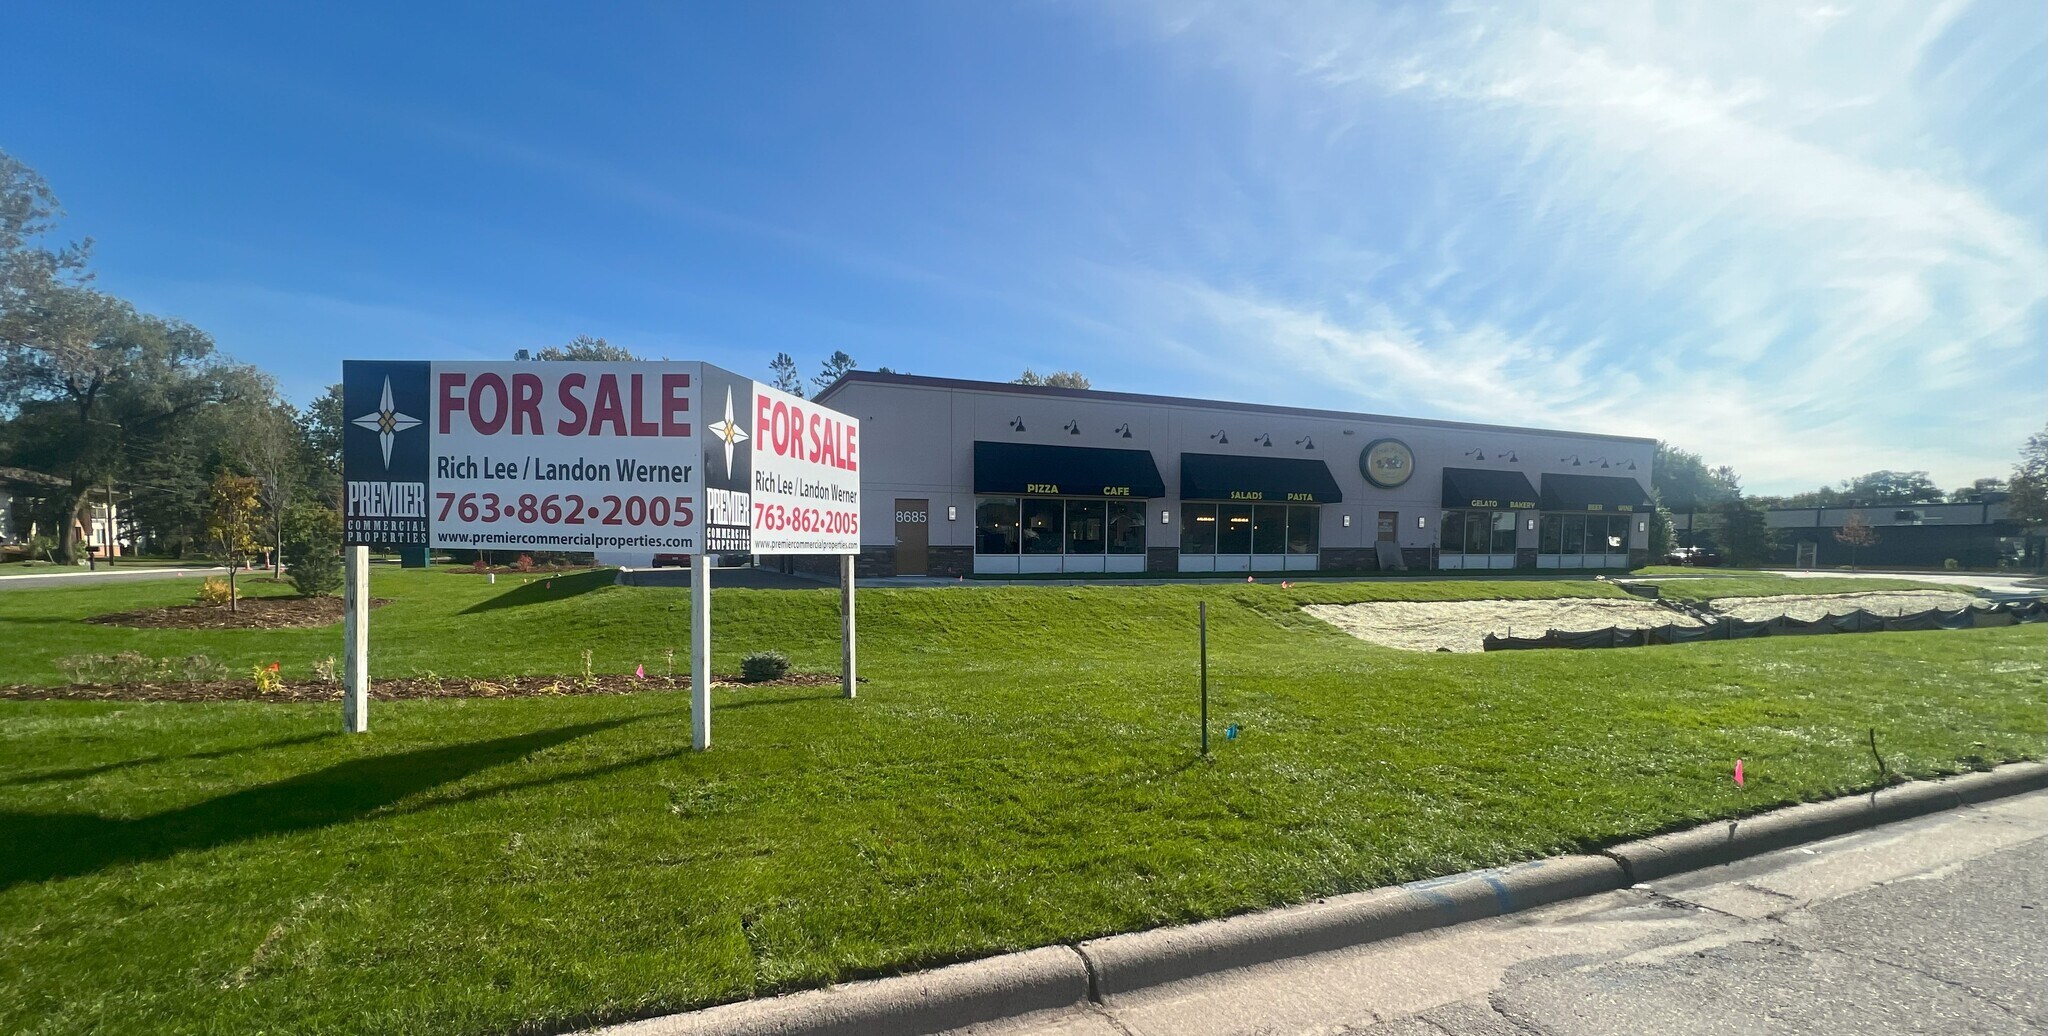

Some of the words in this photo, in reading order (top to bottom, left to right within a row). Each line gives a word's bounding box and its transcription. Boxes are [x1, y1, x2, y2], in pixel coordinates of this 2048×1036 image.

[439, 372, 544, 436] FOR
[557, 373, 691, 437] SALE
[756, 394, 804, 460] FOR
[809, 413, 857, 472] SALE
[437, 456, 477, 479] Rich
[484, 457, 518, 480] Lee
[522, 456, 531, 480] /
[535, 457, 610, 481] Landon
[616, 459, 692, 482] Werner
[755, 470, 776, 493] Rich
[777, 473, 793, 494] Lee
[794, 476, 799, 497] /
[800, 478, 830, 500] Landon
[831, 483, 857, 504] Werner
[1027, 483, 1059, 494] PIZZA
[1103, 486, 1130, 496] CAFE
[347, 481, 427, 518] PREMIER
[1230, 491, 1263, 500] SALADS
[1287, 492, 1314, 501] PASTA
[706, 487, 750, 526] PREMIER
[895, 510, 927, 523] 8685
[347, 519, 427, 532] COMMERCIAL
[347, 532, 427, 544] PROPERTIES
[437, 531, 693, 548] www.premiercommercialproperties.com
[706, 526, 750, 540] COMMERCIAL
[706, 538, 750, 551] PROPERTIES
[754, 539, 858, 552] www.premiercommercialproperties.com
